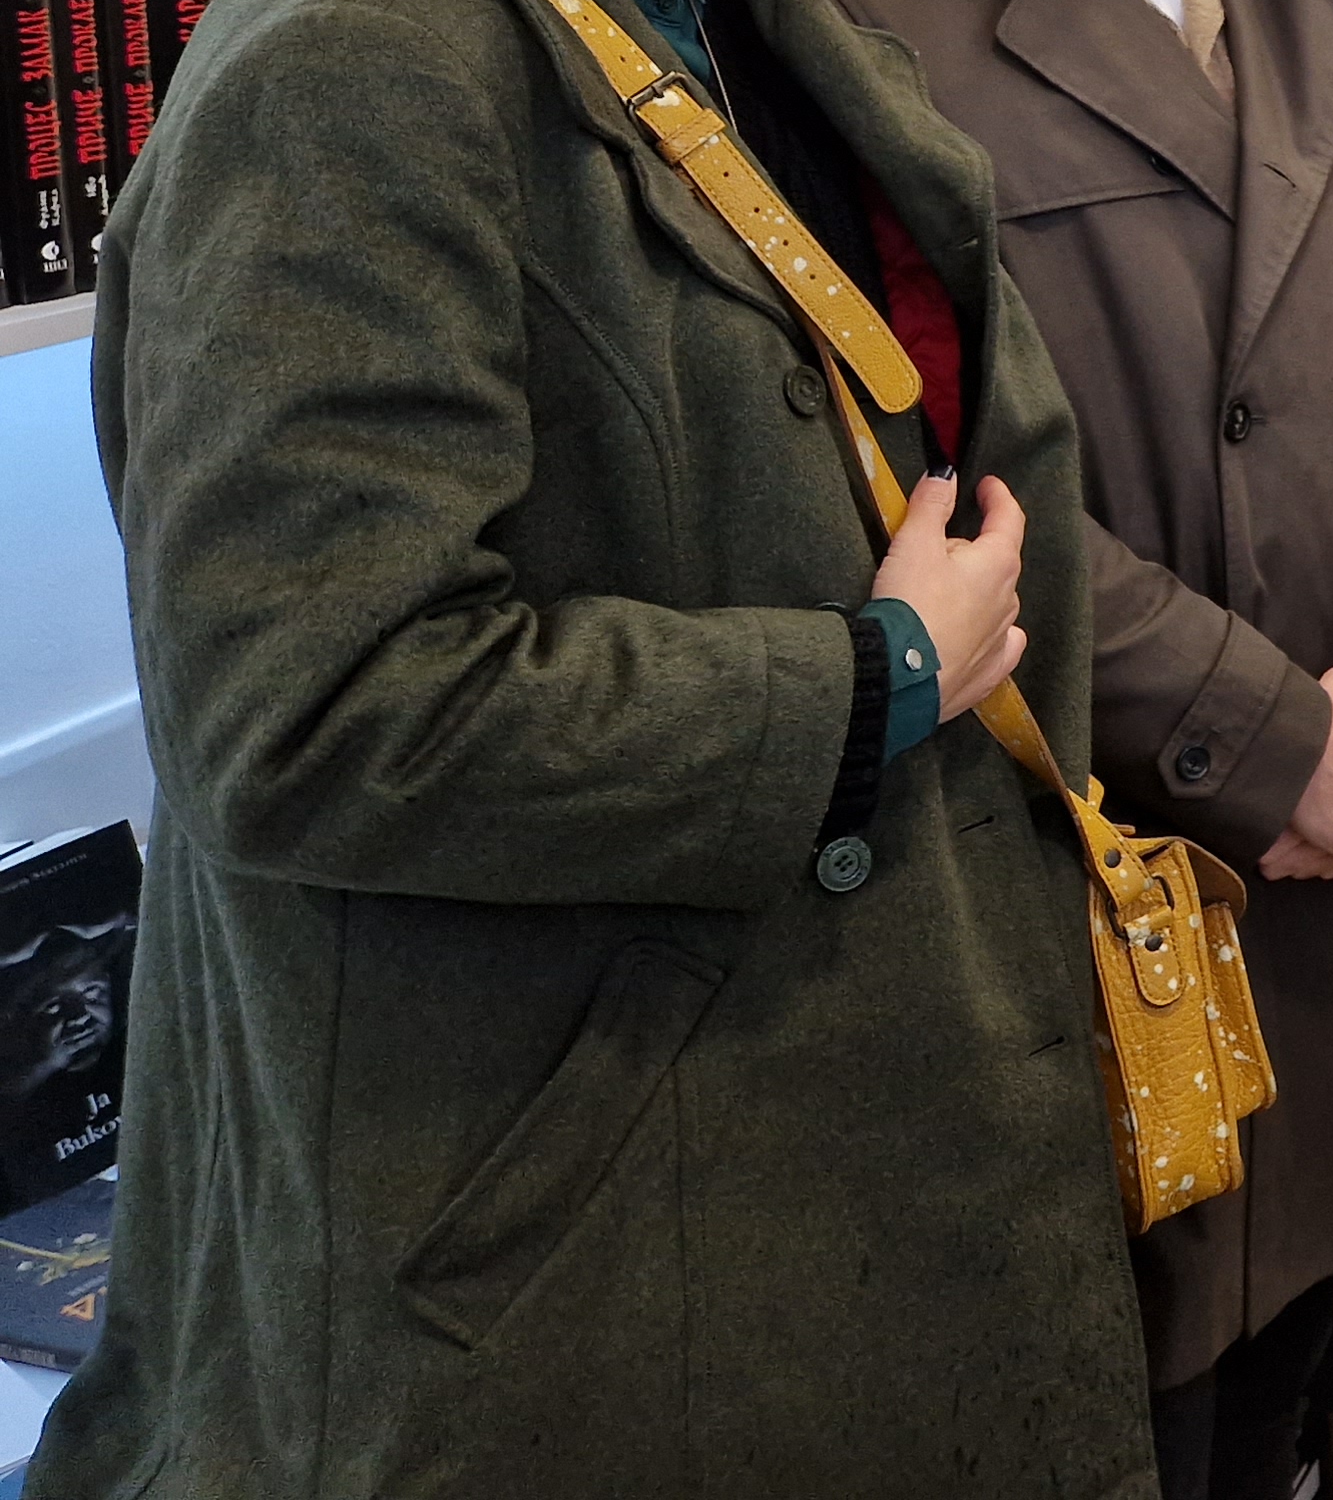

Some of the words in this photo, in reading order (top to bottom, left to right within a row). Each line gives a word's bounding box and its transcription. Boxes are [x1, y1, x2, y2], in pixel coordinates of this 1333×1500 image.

[17, 7, 54, 82] ЗАМАК
[24, 99, 62, 180] ПРОЦЕС
[72, 85, 108, 164] ПРИЧЕ
[86, 1093, 112, 1121] Ja
